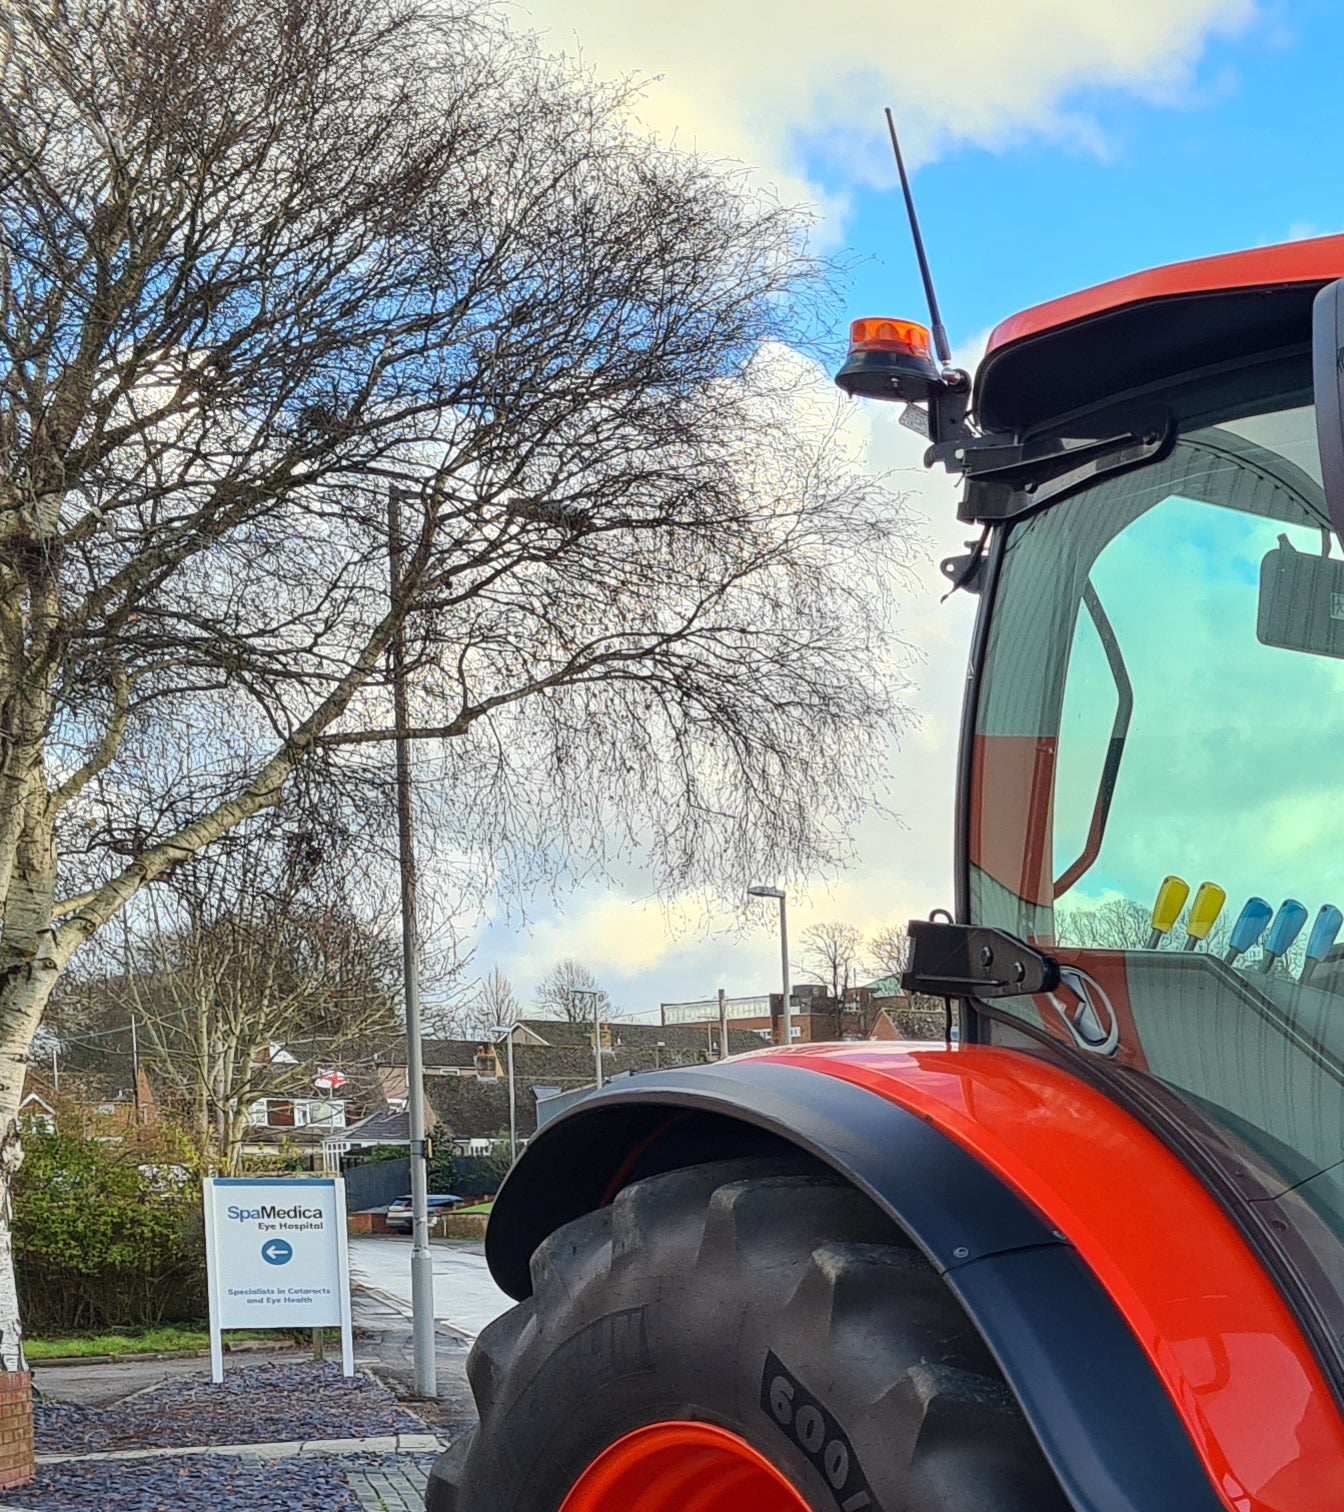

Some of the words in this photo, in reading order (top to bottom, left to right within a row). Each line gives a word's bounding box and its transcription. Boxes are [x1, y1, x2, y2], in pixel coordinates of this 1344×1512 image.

[227, 1205, 323, 1223] SpaMedica
[258, 1222, 277, 1231] Eye
[279, 1222, 324, 1231] Hospital
[228, 1288, 275, 1296] Specialists
[288, 1287, 331, 1295] Cataracts
[266, 1297, 281, 1305] Eye
[283, 1296, 313, 1304] Health
